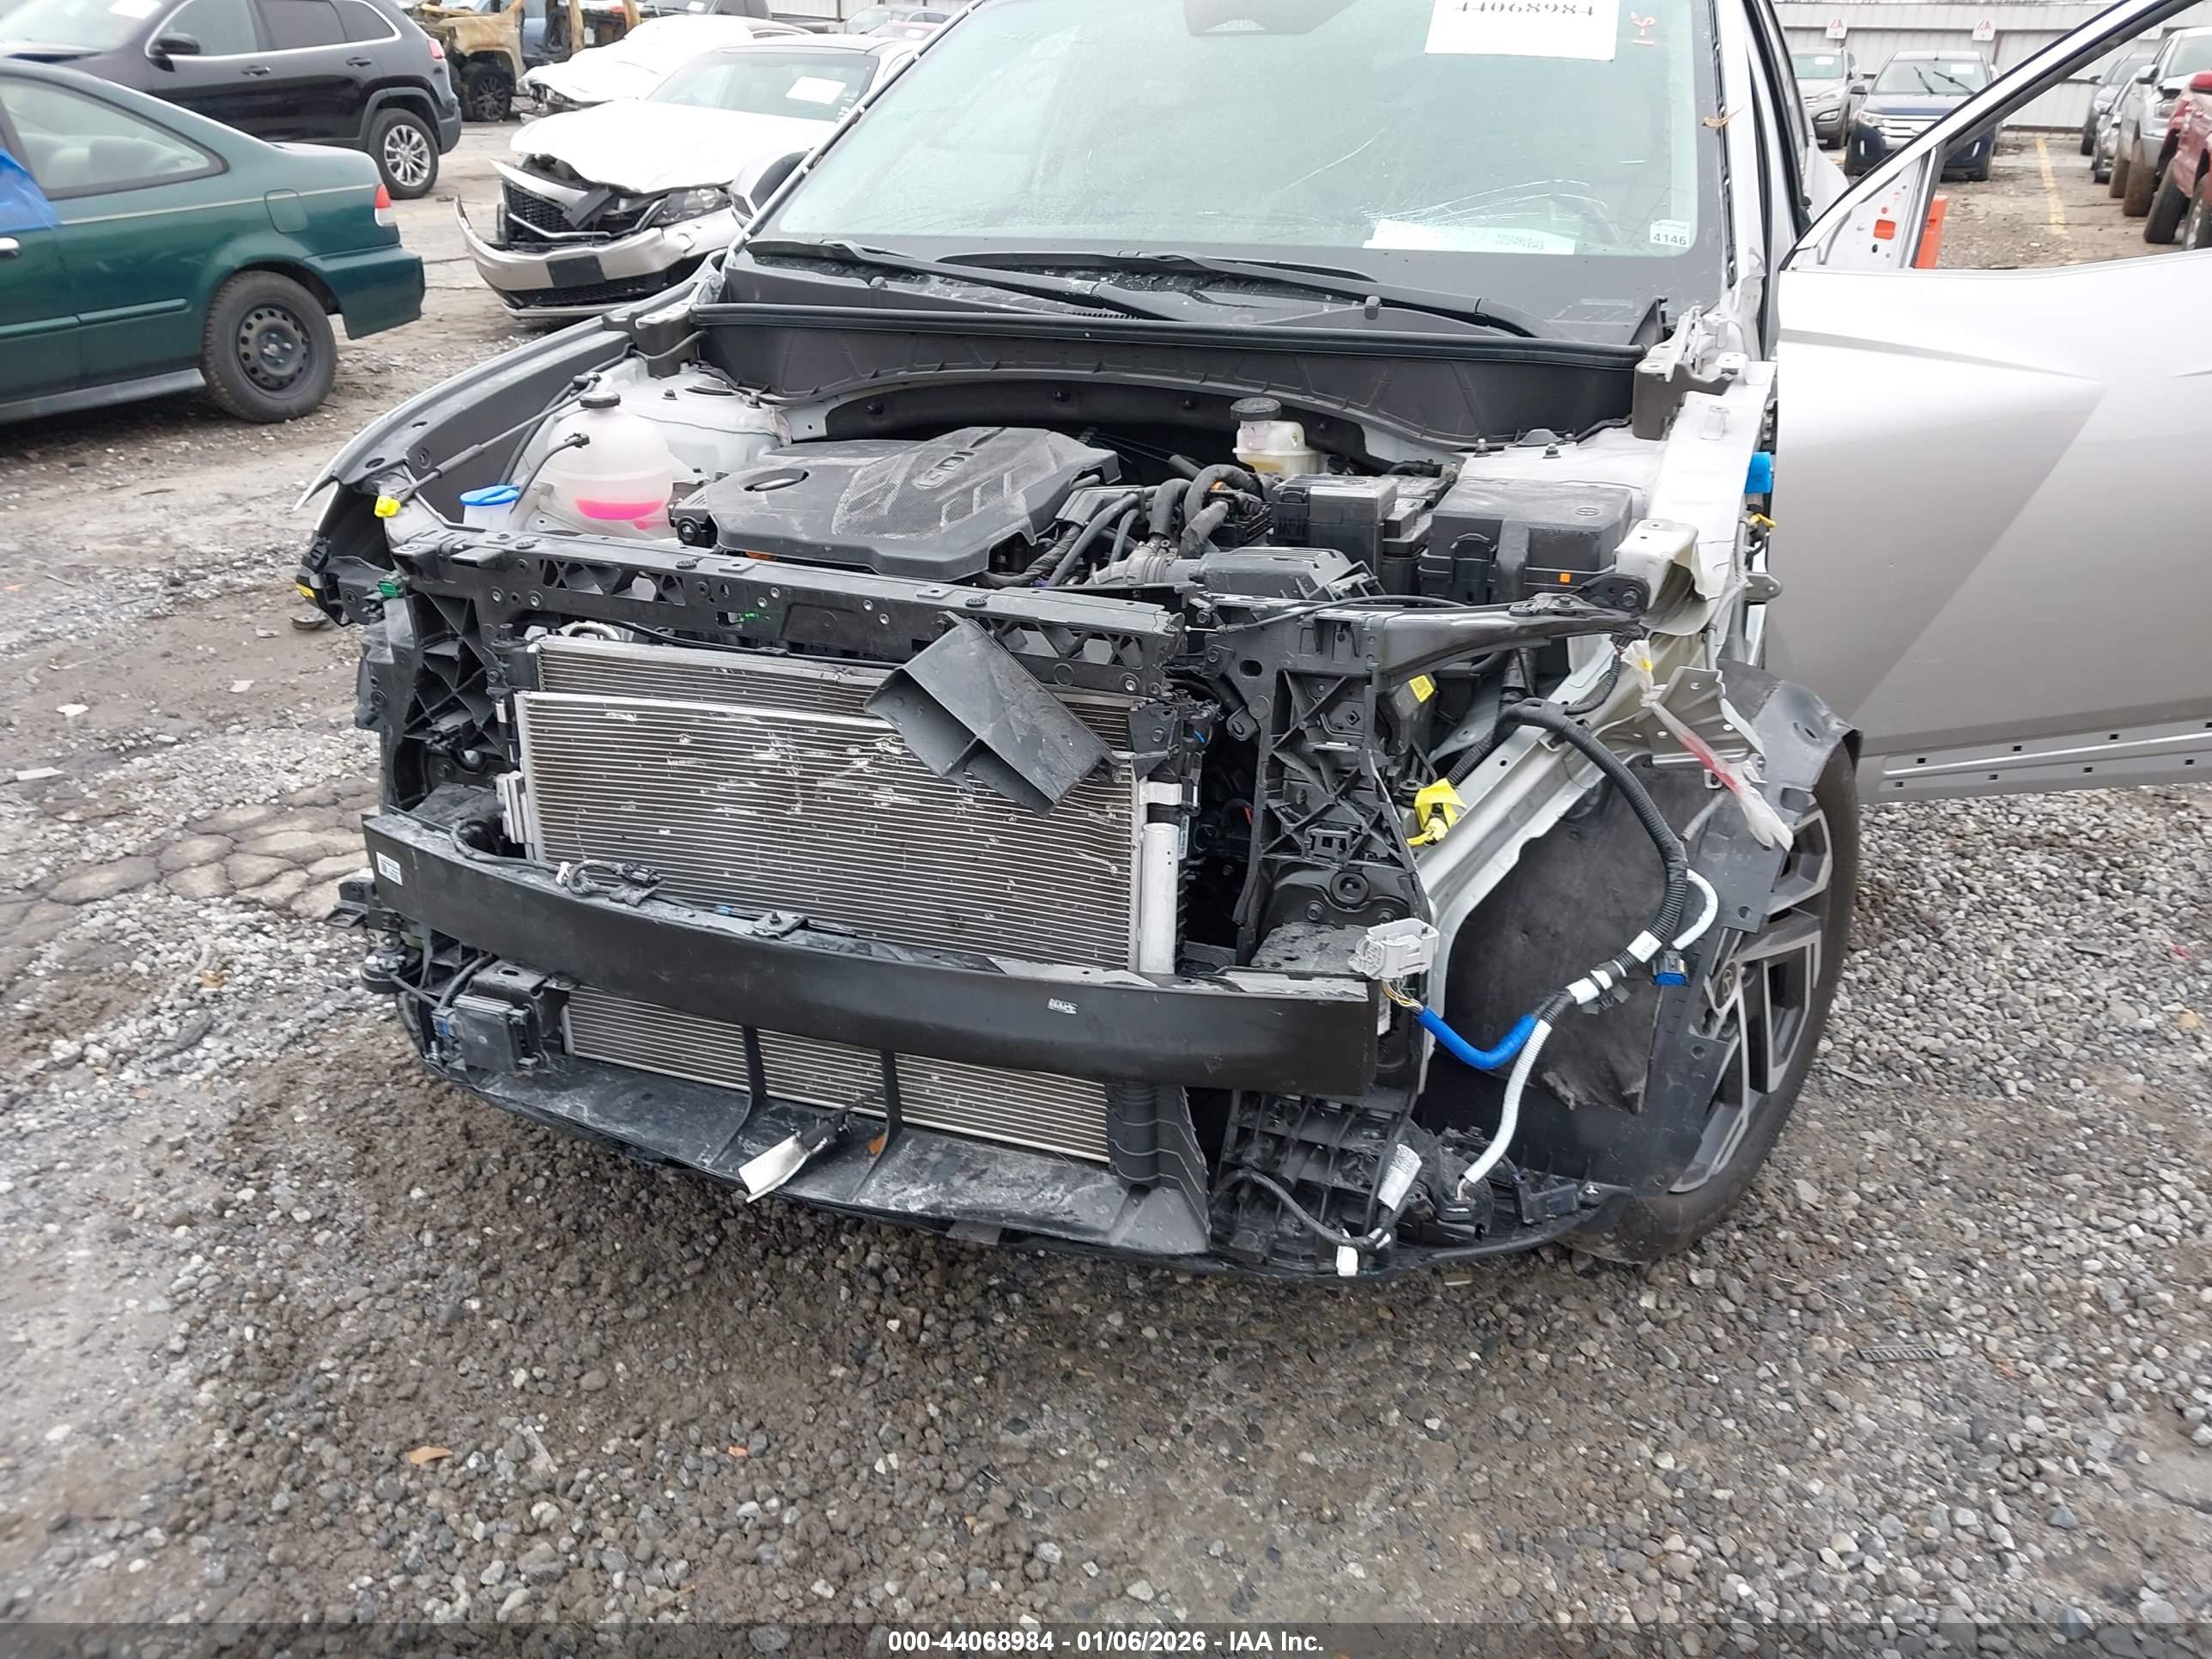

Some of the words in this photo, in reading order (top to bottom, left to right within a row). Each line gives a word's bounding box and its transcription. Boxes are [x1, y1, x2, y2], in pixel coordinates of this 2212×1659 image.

[1454, 1, 1594, 16] 44068984
[1653, 233, 1687, 246] 4146
[915, 450, 977, 489] GDI
